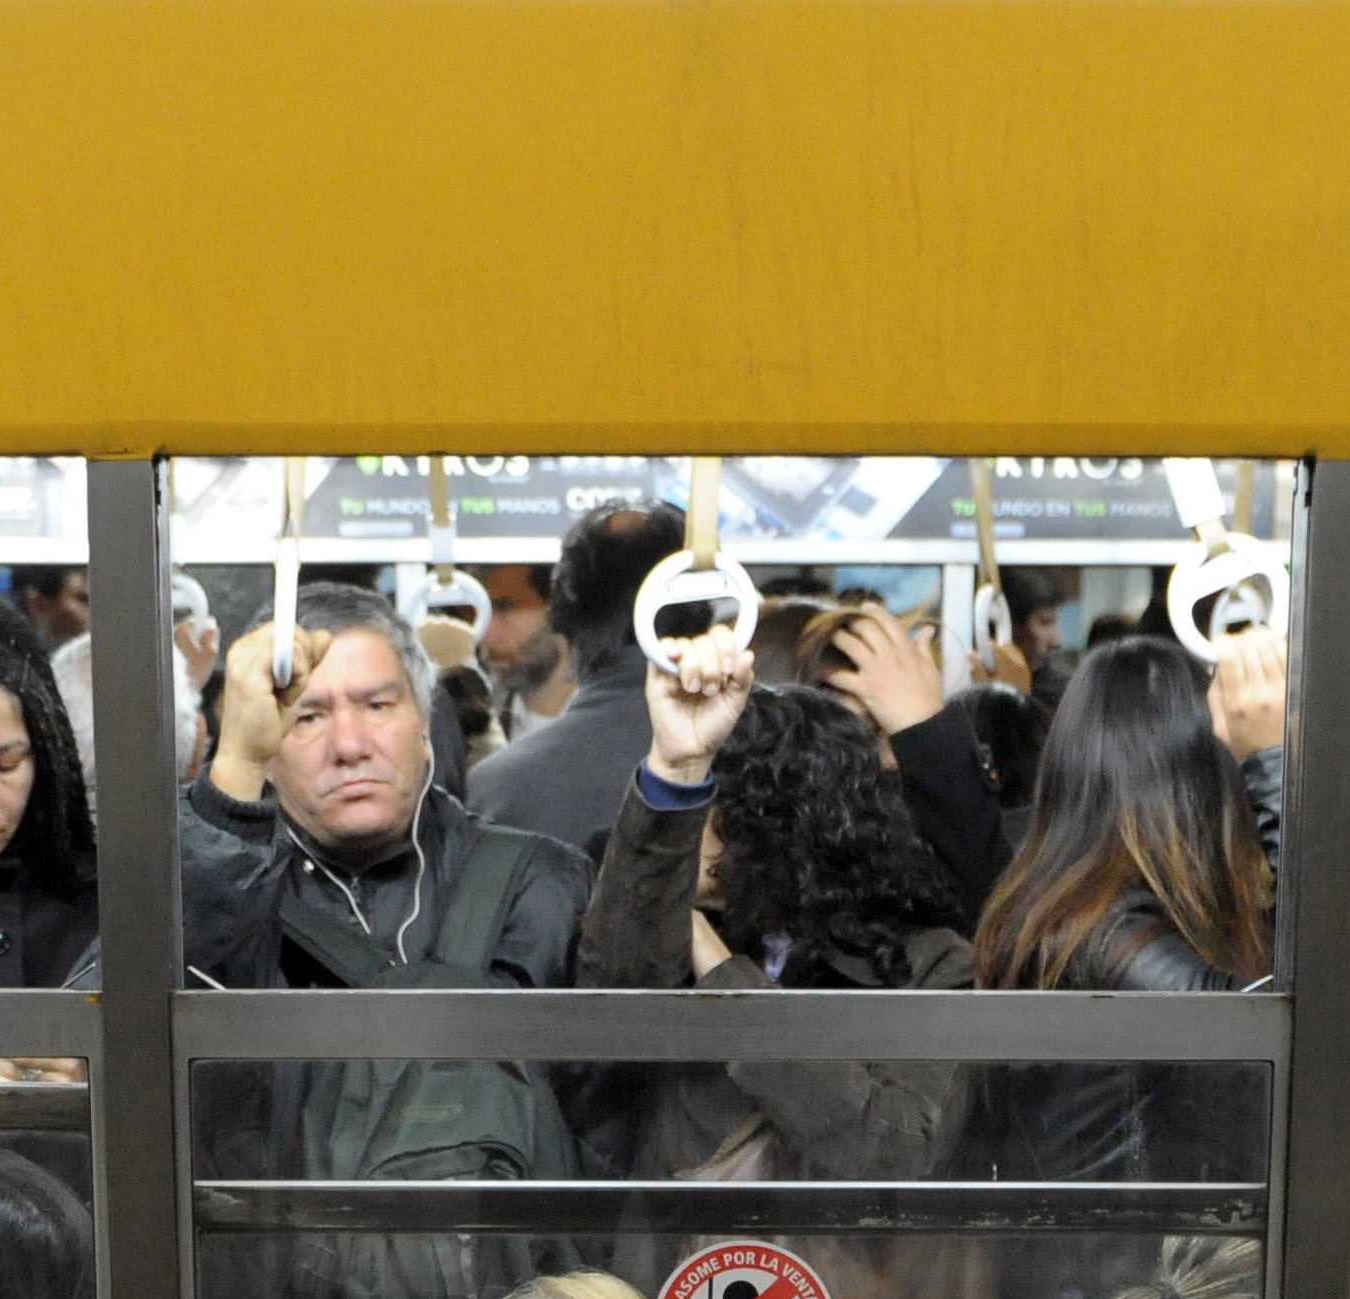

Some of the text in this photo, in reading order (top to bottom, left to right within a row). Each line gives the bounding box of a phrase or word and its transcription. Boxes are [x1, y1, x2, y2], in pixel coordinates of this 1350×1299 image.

[497, 499, 560, 515] MANOS
[952, 498, 976, 517] TU
[992, 499, 1043, 517] UNDO
[1046, 499, 1071, 517] EN
[723, 1251, 755, 1266] POR
[760, 1253, 779, 1271] LA
